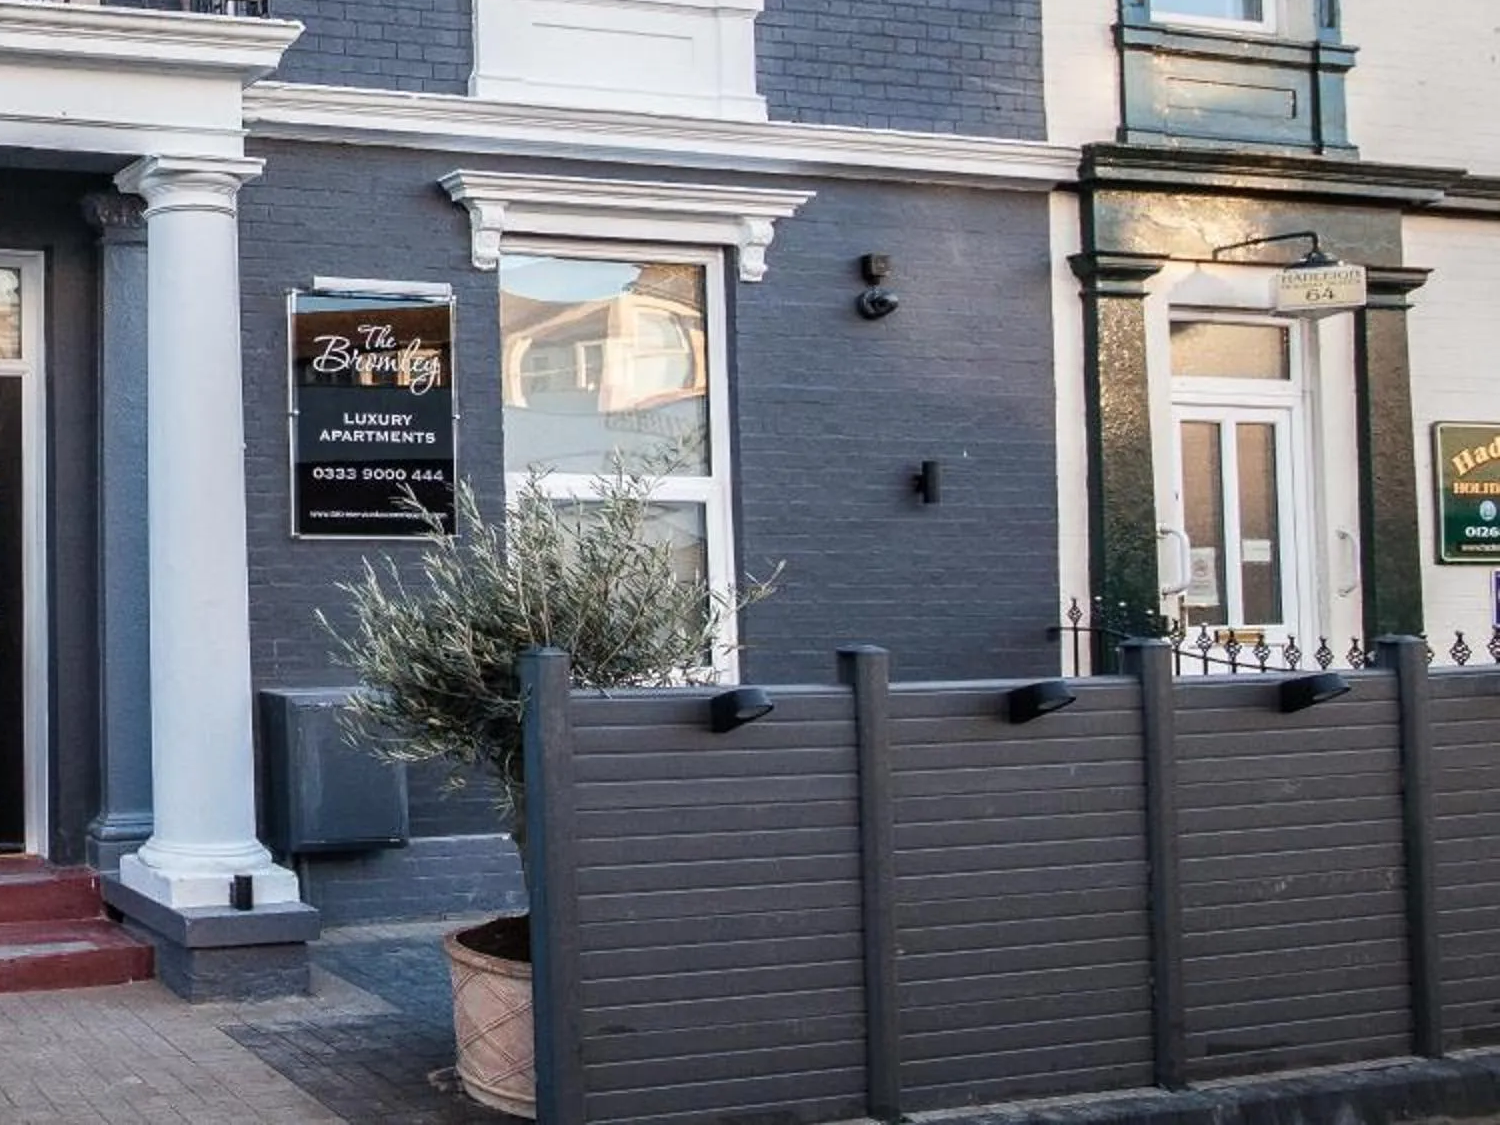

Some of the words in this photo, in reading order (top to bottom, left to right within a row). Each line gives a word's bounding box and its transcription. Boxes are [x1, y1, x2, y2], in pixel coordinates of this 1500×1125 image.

[1305, 287, 1335, 302] 64
[357, 324, 397, 350] The
[313, 336, 440, 396] Bromley
[343, 412, 413, 426] LUXURY
[319, 429, 436, 444] APARTMENTS
[312, 466, 357, 480] 0333
[361, 468, 407, 480] 9000
[411, 469, 444, 481] 444
[1465, 526, 1500, 538] 0126
